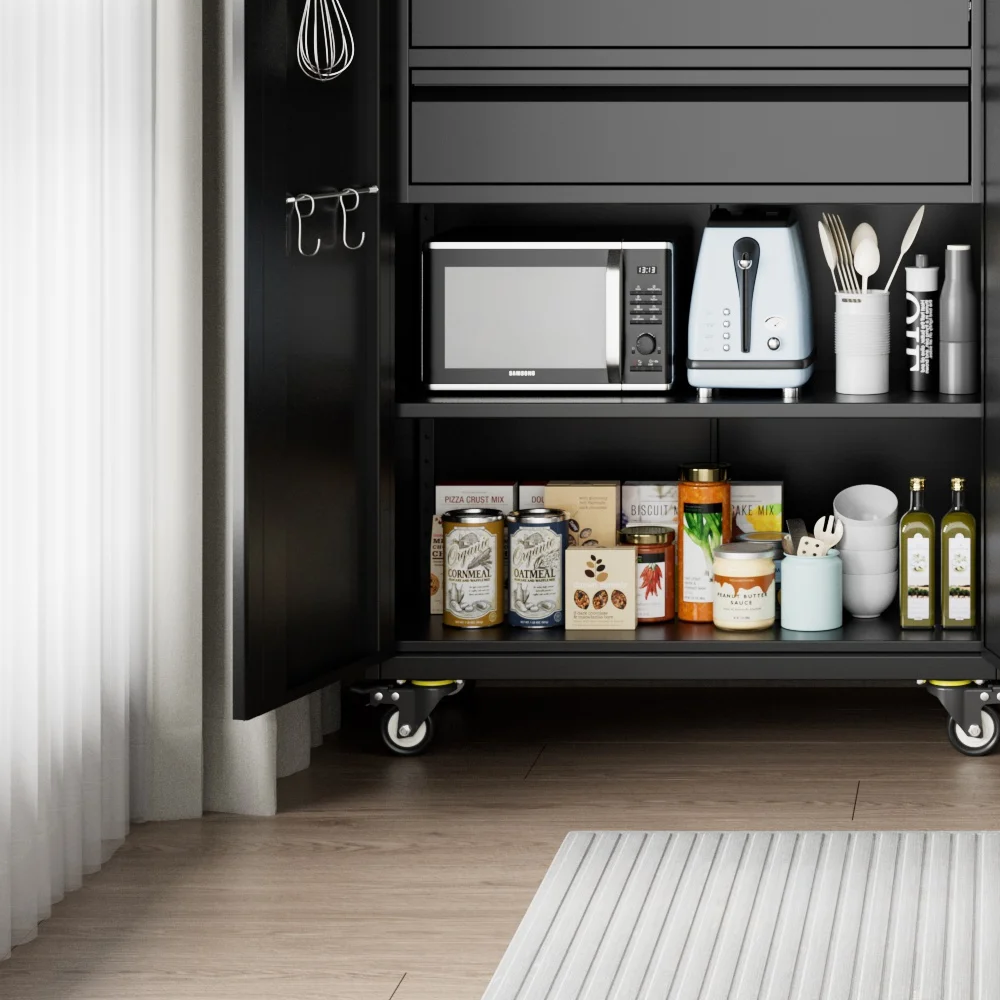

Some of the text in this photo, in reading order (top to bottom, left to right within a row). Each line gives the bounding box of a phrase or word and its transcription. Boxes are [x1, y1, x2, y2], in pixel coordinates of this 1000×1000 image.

[631, 505, 668, 516] BISCUIT
[758, 505, 774, 516] MIX
[448, 568, 492, 578] CORNMEAL
[514, 568, 556, 578] OATMEAL
